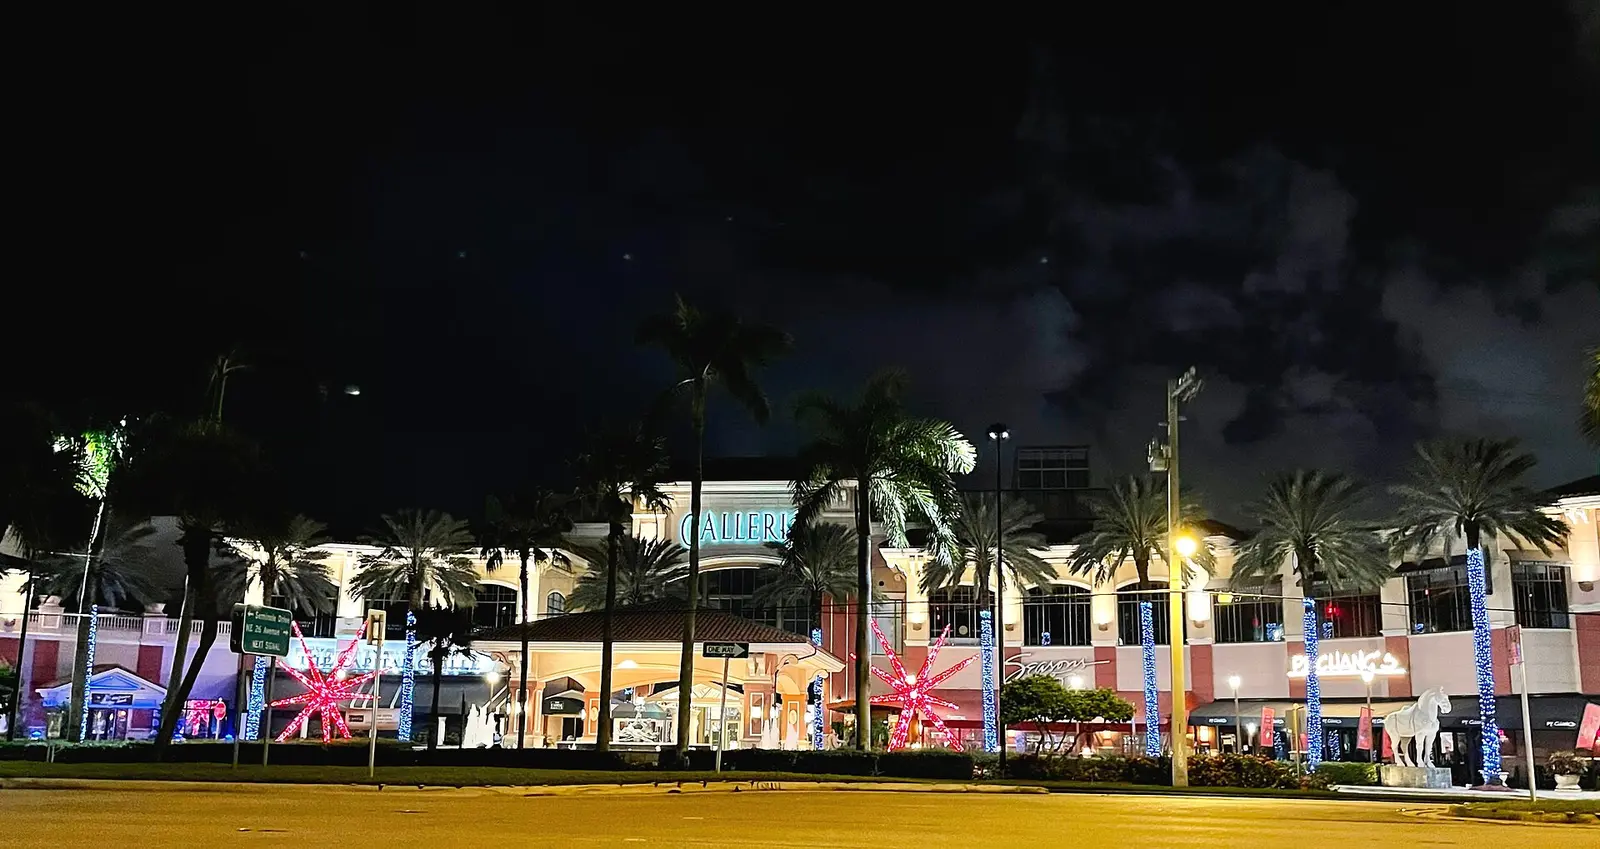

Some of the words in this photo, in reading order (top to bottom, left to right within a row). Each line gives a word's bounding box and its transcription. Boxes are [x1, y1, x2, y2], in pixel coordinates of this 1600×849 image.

[681, 512, 788, 546] GALLERI
[263, 627, 280, 636] Avenue
[1004, 652, 1110, 685] Seasons
